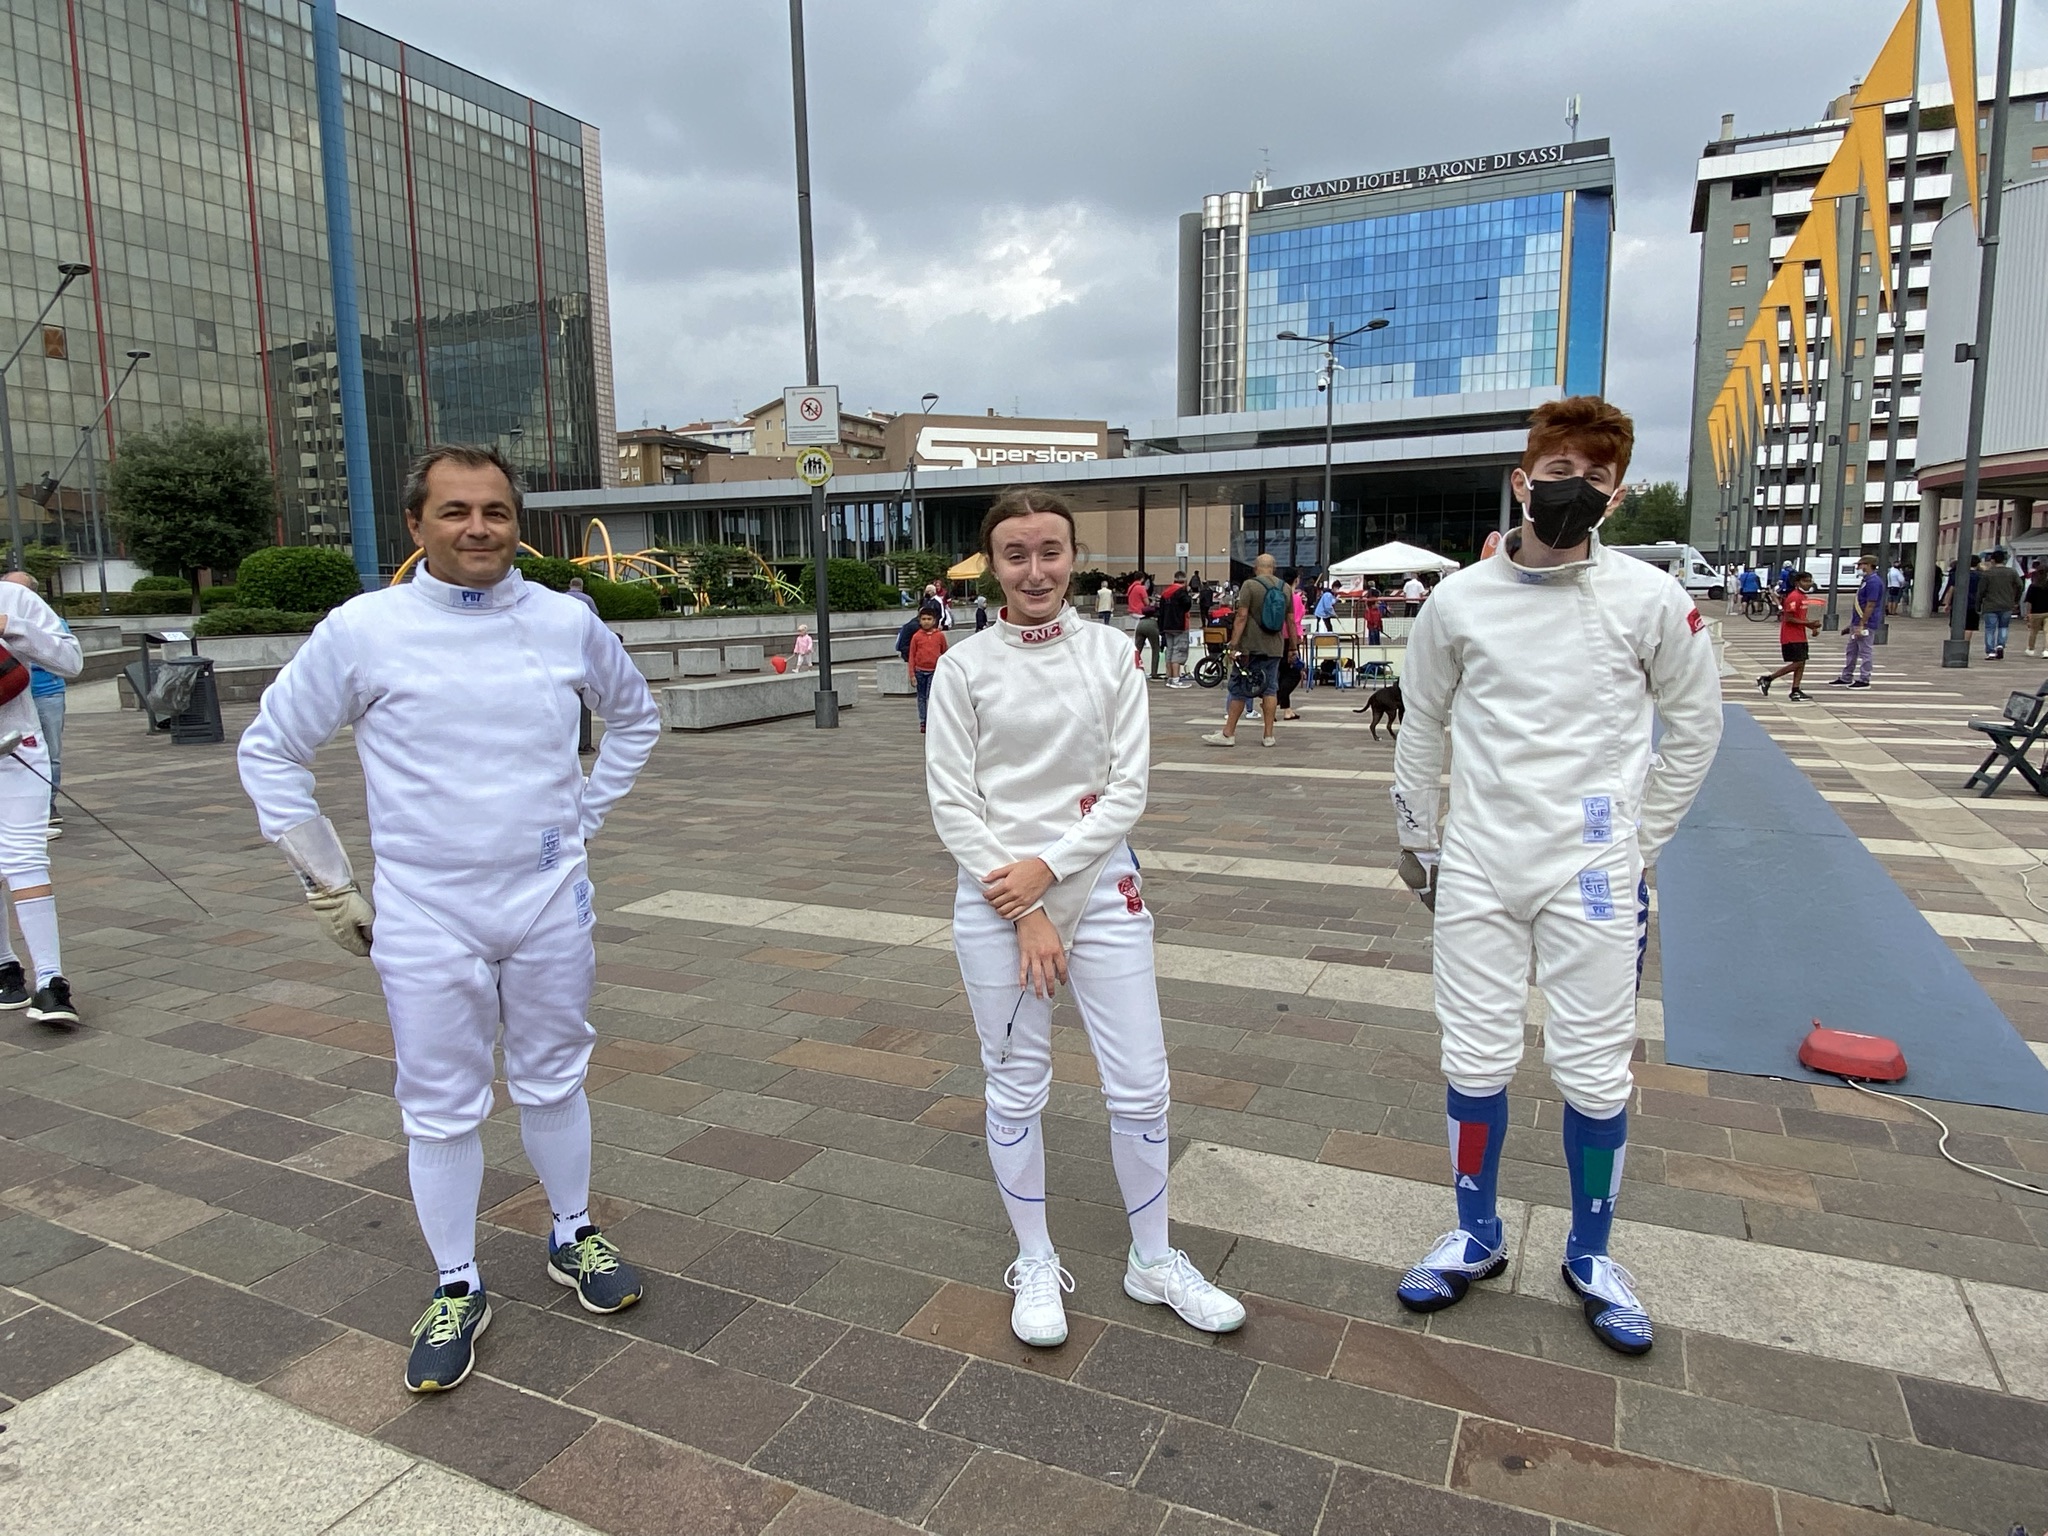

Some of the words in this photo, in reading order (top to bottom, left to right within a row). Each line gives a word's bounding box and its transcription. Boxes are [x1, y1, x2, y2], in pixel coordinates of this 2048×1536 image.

[1291, 179, 1351, 199] GRAND
[1356, 169, 1411, 190] HOTEL
[1417, 157, 1487, 181] BARONE
[1494, 153, 1512, 169] DI
